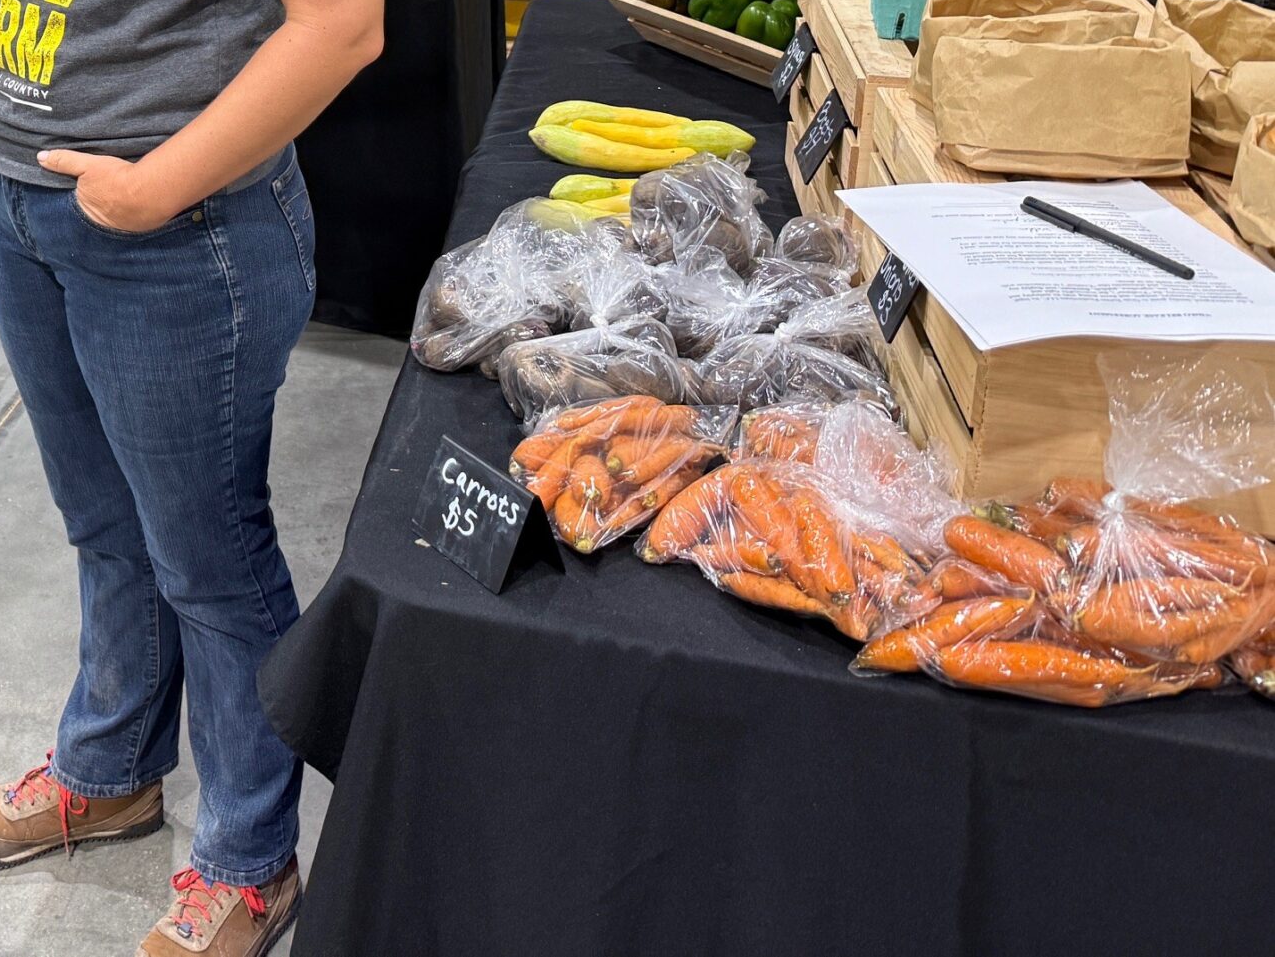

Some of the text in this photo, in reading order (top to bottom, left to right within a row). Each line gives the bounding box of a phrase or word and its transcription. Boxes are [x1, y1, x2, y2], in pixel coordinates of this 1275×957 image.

[3, 77, 49, 100] COUNTRY
[442, 457, 520, 525] Carrots
[441, 496, 478, 536] $5
